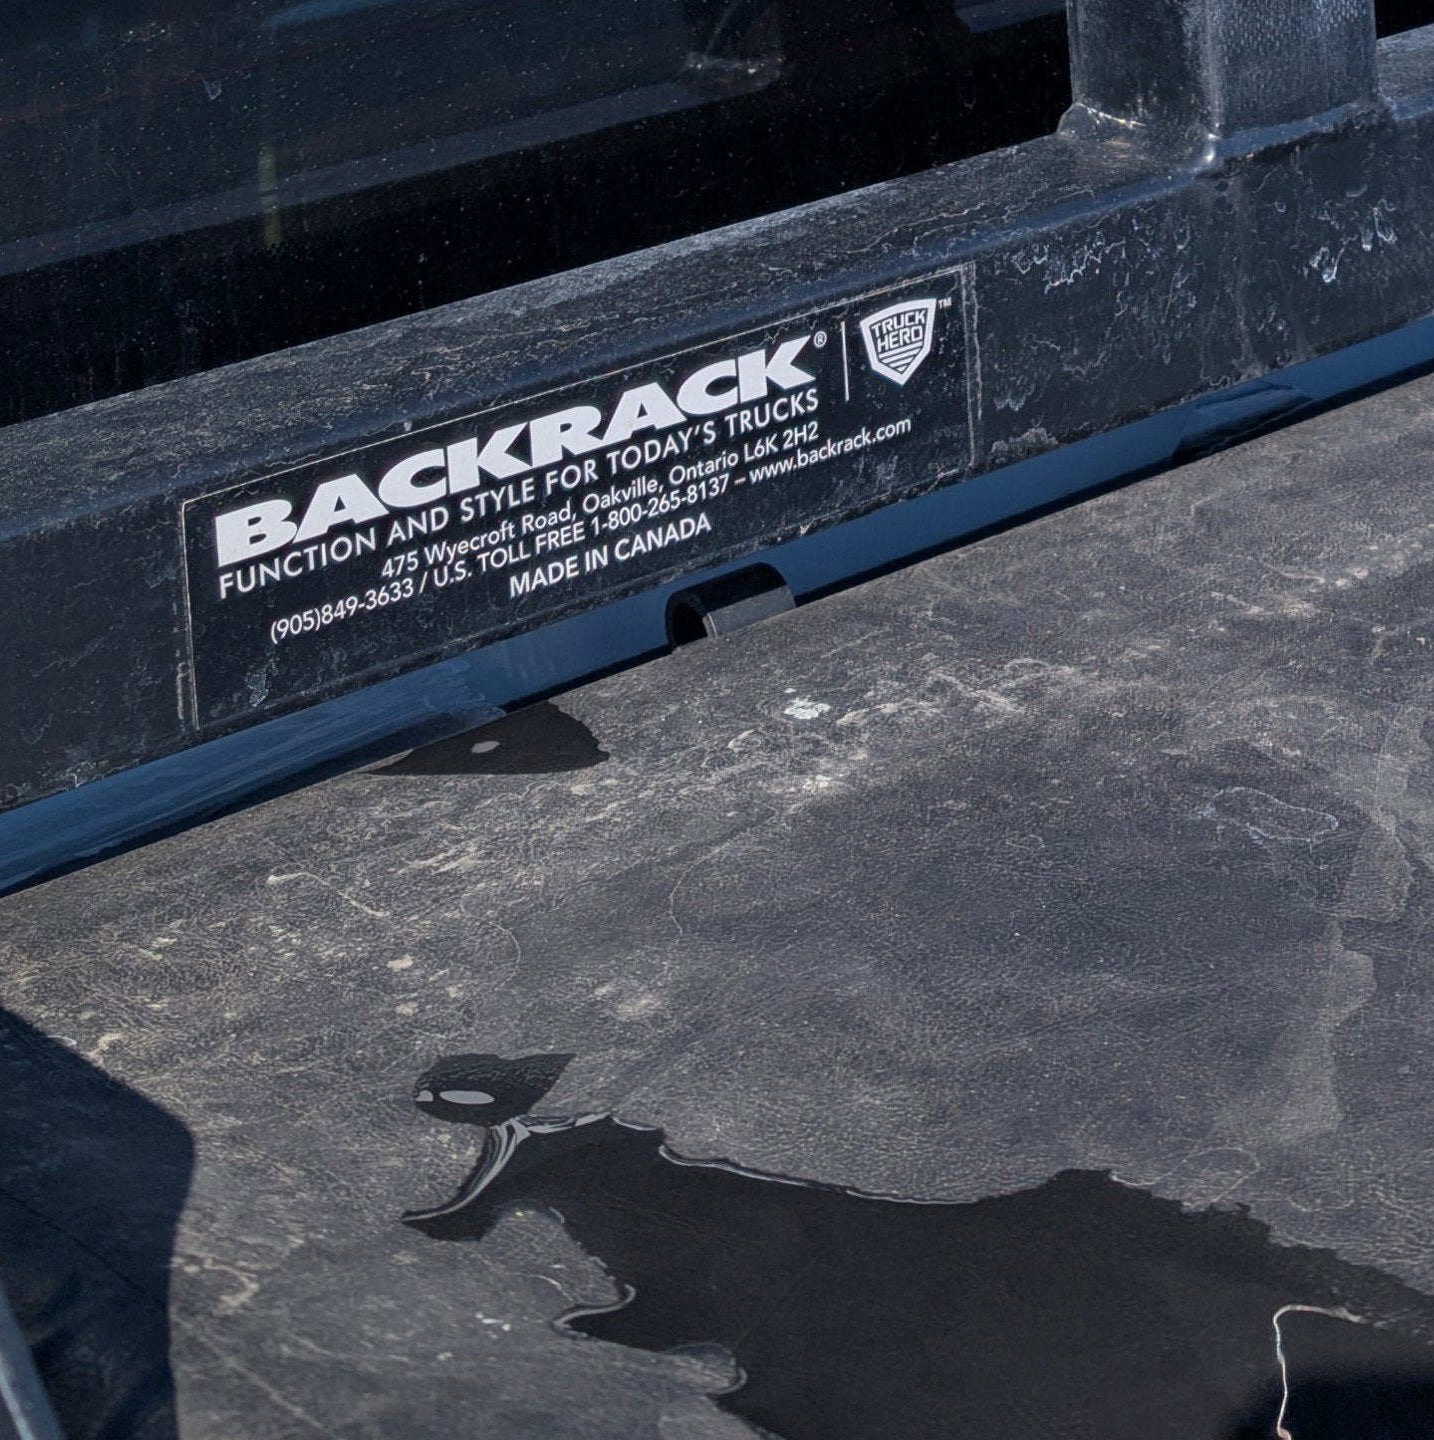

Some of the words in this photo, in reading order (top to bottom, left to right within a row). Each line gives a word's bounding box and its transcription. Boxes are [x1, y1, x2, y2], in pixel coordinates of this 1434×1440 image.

[871, 310, 926, 338] TRUCK
[877, 326, 923, 352] HERO
[219, 527, 377, 599] FUNCTION
[387, 506, 449, 548] AND
[460, 477, 535, 523] STYLE
[545, 459, 599, 497] FOR
[606, 421, 716, 476] TODAY'S
[725, 388, 819, 438] TRUCKS
[270, 579, 415, 645] (905)849-3633
[433, 560, 472, 588] U.S.
[476, 538, 531, 573] TOLL
[534, 519, 586, 555] FREE
[590, 473, 729, 537] 1-800-265-8137
[750, 417, 912, 485] www.backrack.com
[381, 550, 419, 579] 475
[425, 519, 516, 566] Wyecroft
[521, 497, 578, 535] Road,
[582, 476, 664, 515] Oakville,
[668, 450, 739, 487] Ontario
[743, 433, 779, 463] L6K
[782, 421, 819, 450] 2H2
[510, 554, 579, 599] MADE
[584, 544, 609, 574] IN
[615, 512, 712, 562] CANADA
